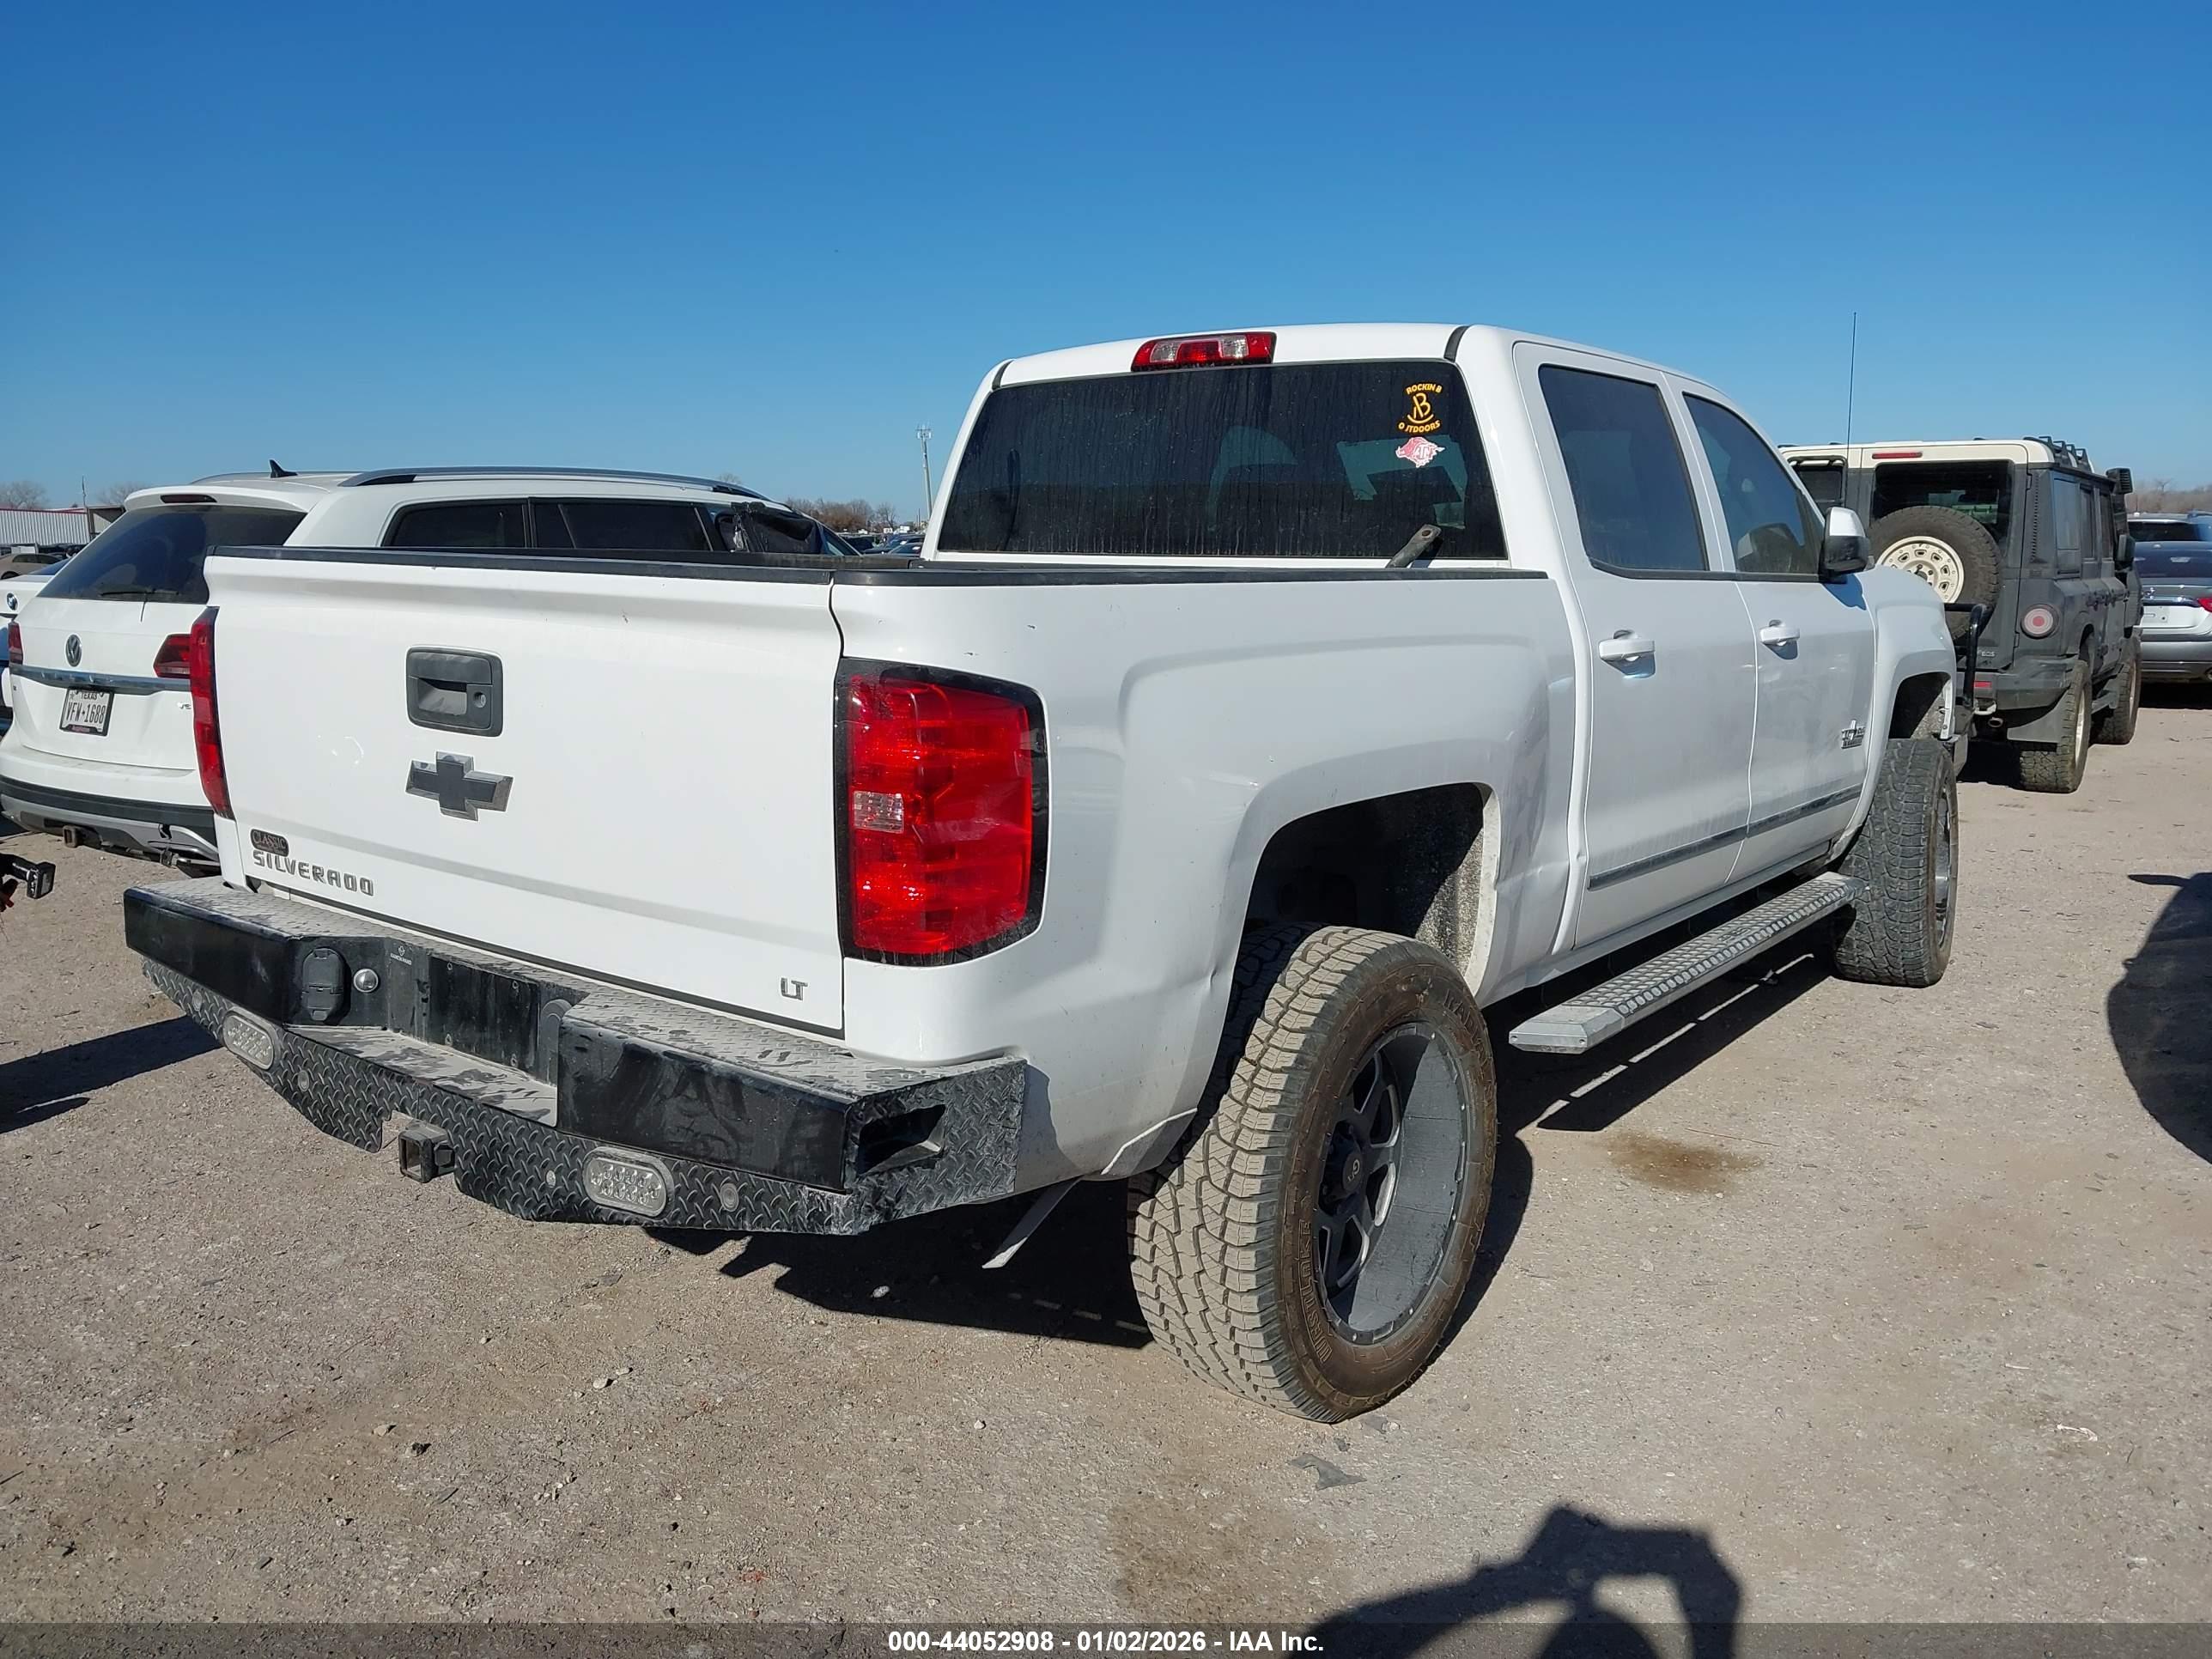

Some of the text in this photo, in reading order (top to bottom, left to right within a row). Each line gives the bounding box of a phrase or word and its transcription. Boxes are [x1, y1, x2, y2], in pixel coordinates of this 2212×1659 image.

[1406, 383, 1443, 395] ROCKIN B
[81, 692, 98, 701] TEXAS
[252, 830, 287, 849] CLASSIC
[253, 849, 374, 896] SILVERADO
[781, 977, 809, 1001] LT
